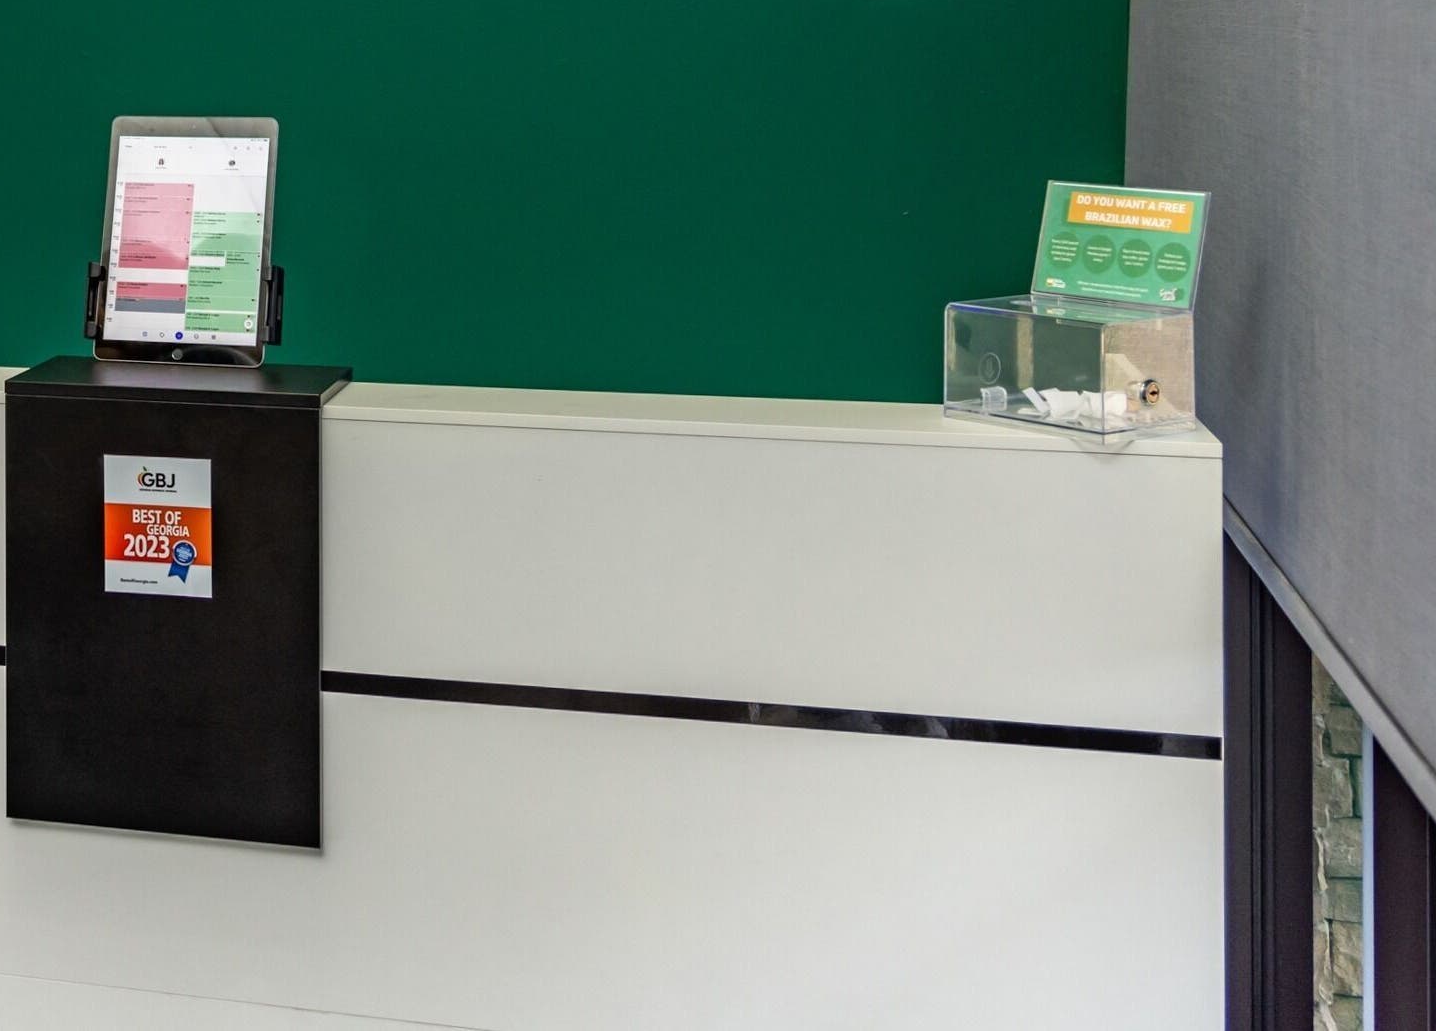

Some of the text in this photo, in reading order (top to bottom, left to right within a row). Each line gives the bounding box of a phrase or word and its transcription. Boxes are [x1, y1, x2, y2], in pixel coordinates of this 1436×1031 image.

[1077, 195, 1187, 214] DO YOU WANT A FREE
[1084, 211, 1173, 228] BRAZILIAN WAX?
[142, 472, 175, 488] GBJ
[132, 509, 181, 525] BEST OF
[146, 524, 190, 537] GEORGIA
[123, 534, 170, 558] 2023
